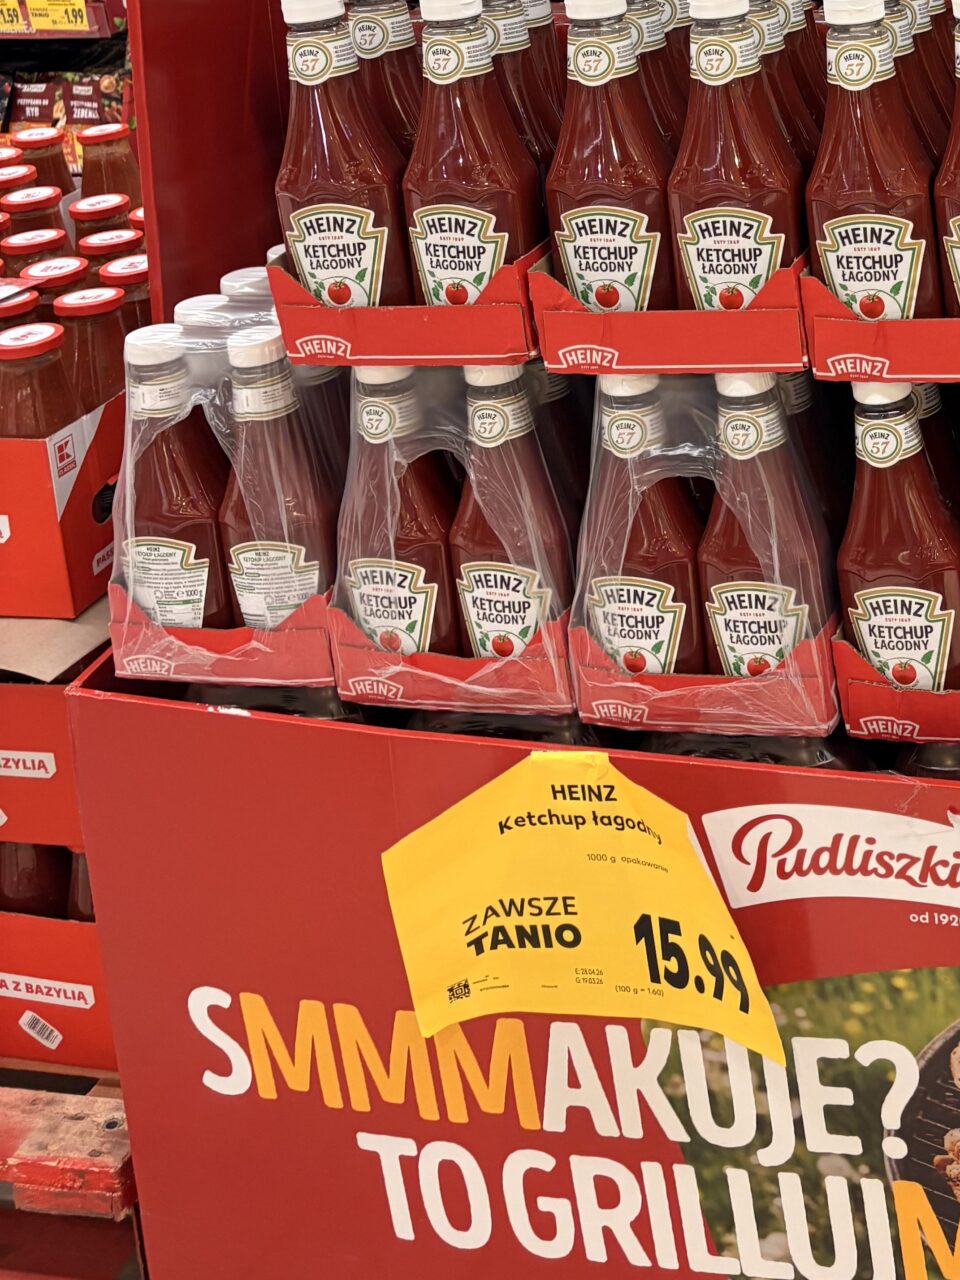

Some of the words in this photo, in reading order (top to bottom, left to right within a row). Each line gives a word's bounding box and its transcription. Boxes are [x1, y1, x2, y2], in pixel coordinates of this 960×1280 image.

[65, 8, 84, 24] 1.99
[431, 48, 452, 59] HEINZ
[703, 47, 725, 59] HEINZ
[432, 57, 451, 71] 57
[704, 58, 725, 71] 57
[303, 217, 356, 237] HEINZ
[699, 220, 754, 240] HEINZ
[304, 242, 367, 260] KETCHUP
[696, 247, 763, 263] KETCHUP
[309, 257, 363, 270] ŁAGODNY
[702, 262, 758, 275] ŁAGODNY
[299, 340, 345, 357] HEINZ
[834, 357, 886, 376] HEINZ
[473, 573, 524, 594] HEINZ
[471, 597, 531, 615] KETCHUP
[869, 598, 926, 618] HEINZ
[476, 612, 528, 625] ŁAGODNY
[868, 624, 934, 639] KETCHUP
[873, 638, 930, 651] ŁAGODNY
[866, 719, 915, 737] HEINZ
[551, 784, 618, 803] HEINZ
[498, 810, 587, 835] Ketchup
[593, 811, 663, 845] łagodny
[586, 853, 608, 863] 1000
[610, 855, 616, 864] g
[621, 855, 669, 874] opakowanie
[462, 896, 579, 937] ZAWSZE
[909, 912, 929, 924] od
[466, 923, 582, 957] TANIO
[633, 913, 750, 1015] 15.99
[25, 982, 87, 1005] BAZYLIĄ
[187, 986, 921, 1167] SMMMAKUJE?
[356, 1132, 493, 1251] TO
